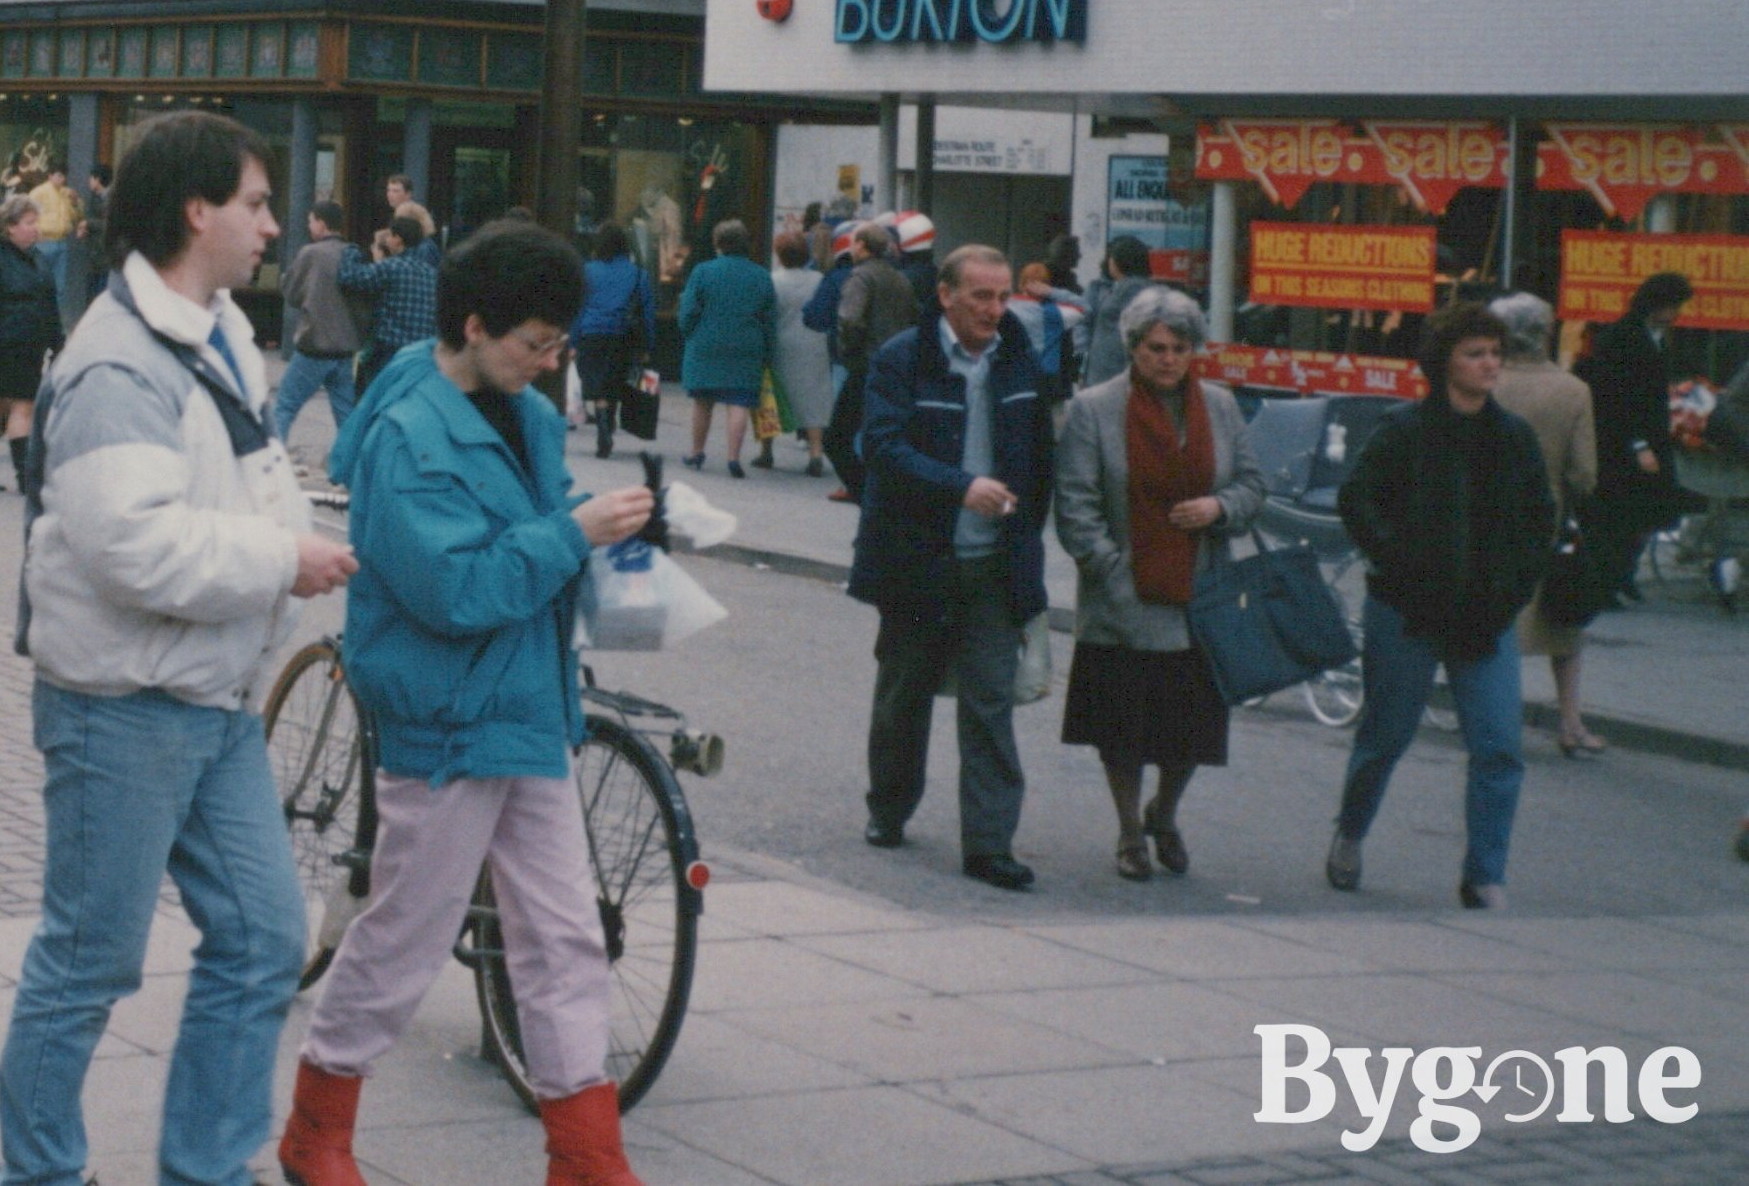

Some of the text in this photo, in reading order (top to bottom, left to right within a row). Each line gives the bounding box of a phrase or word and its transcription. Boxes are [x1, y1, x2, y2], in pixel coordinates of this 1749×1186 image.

[1241, 121, 1342, 177] sale
[1384, 122, 1494, 181] sale
[1570, 126, 1691, 187] sale
[1255, 231, 1429, 267] HUGE REDUCTIONS
[1566, 240, 1627, 275] HUGE
[1365, 370, 1397, 390] SALE
